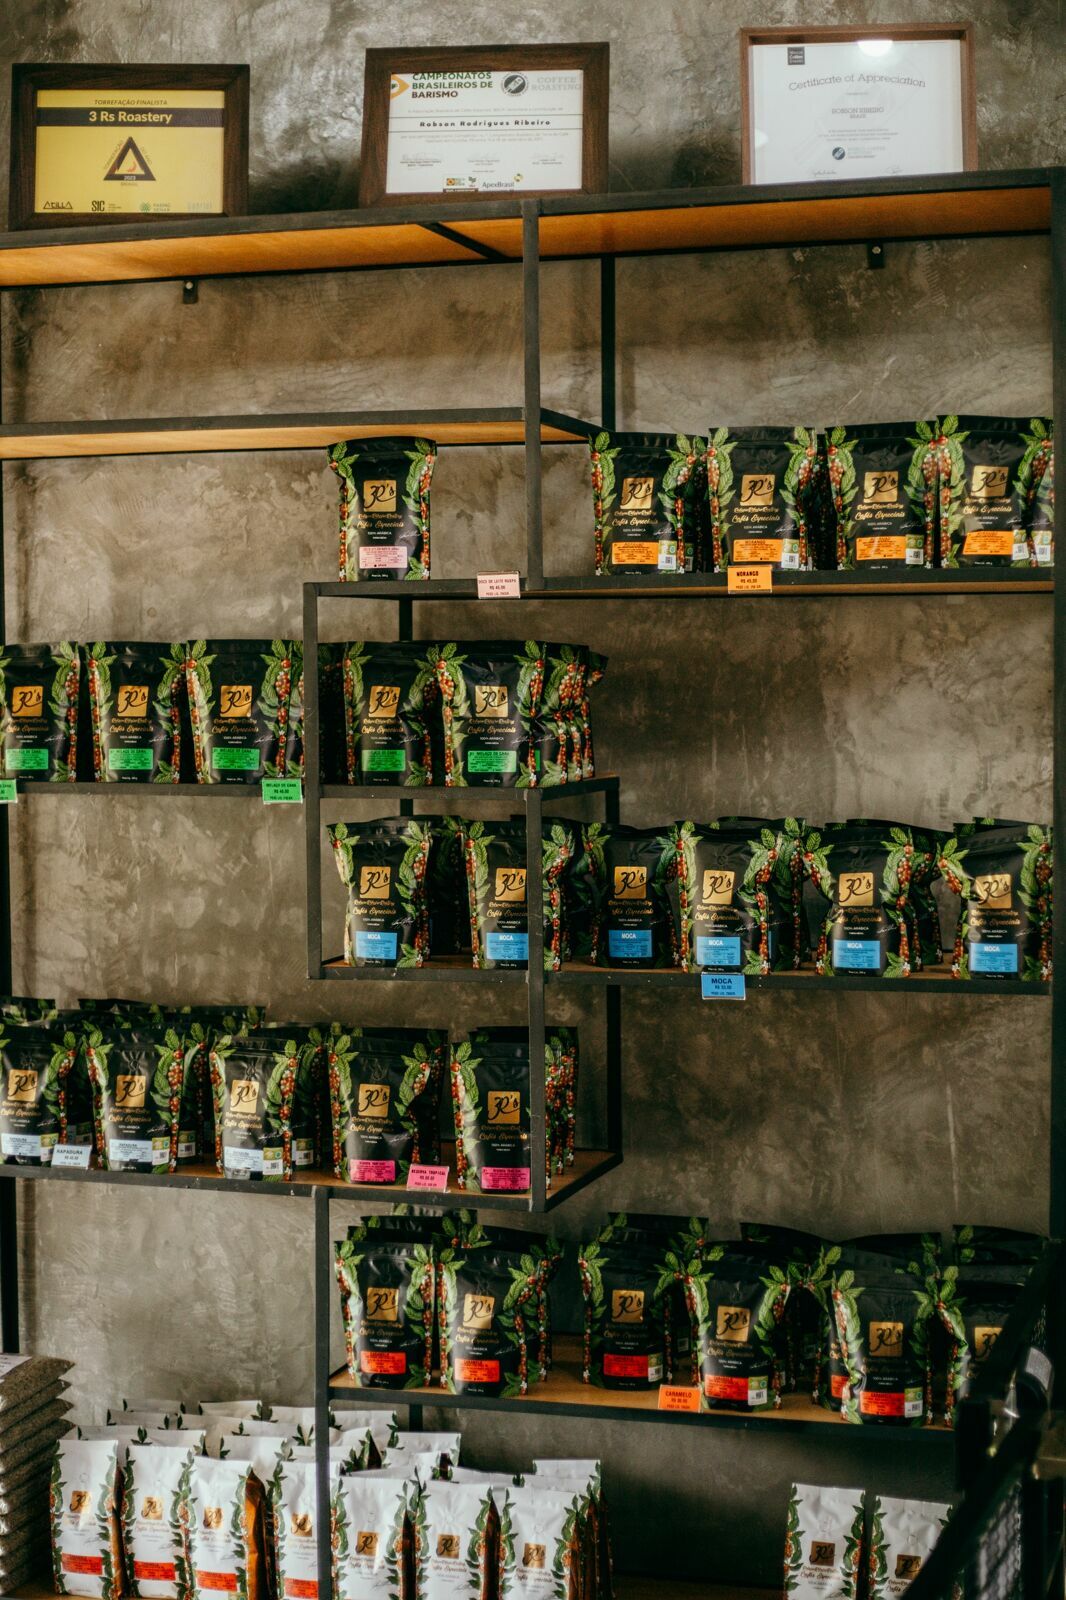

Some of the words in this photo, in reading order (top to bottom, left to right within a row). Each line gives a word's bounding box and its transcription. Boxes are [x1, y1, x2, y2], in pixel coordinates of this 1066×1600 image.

[412, 72, 492, 80] CAMPEONATOS
[789, 75, 842, 91] Certificate
[857, 73, 926, 88] Appreciation
[89, 111, 96, 121] 3
[101, 111, 114, 121] Rs
[118, 111, 172, 123] Roastery
